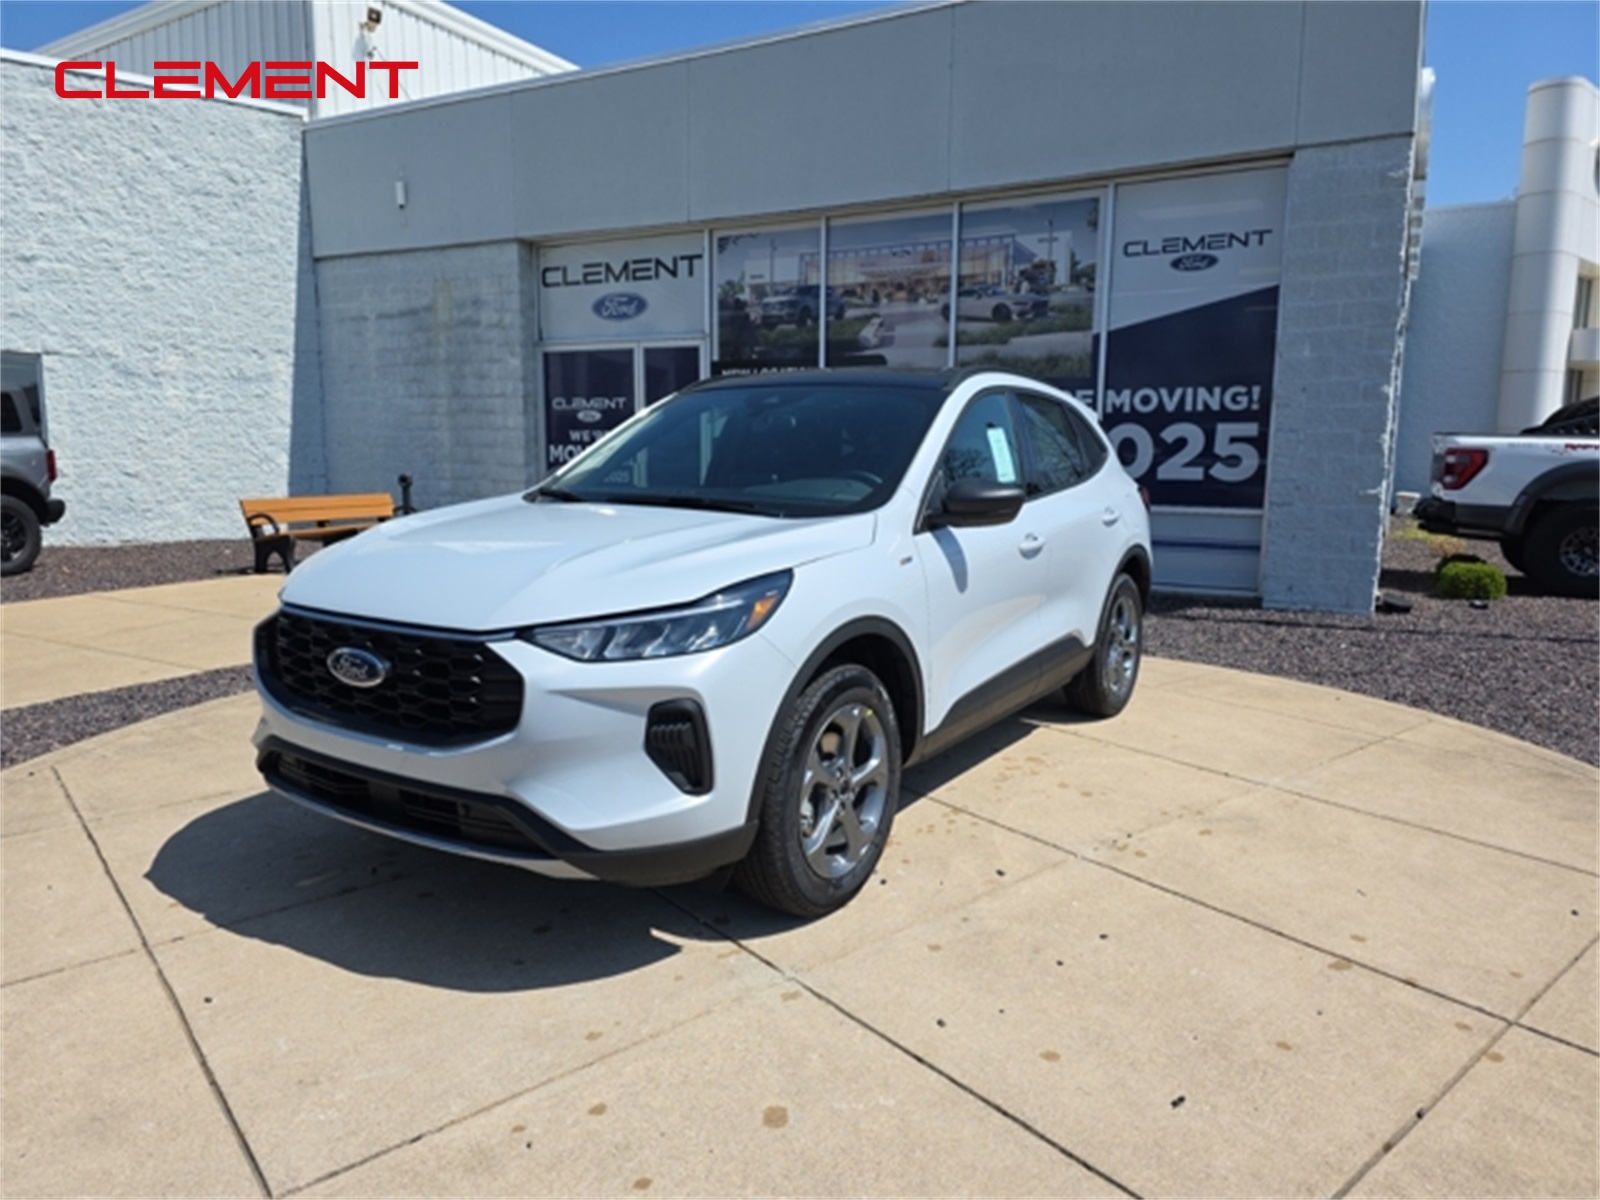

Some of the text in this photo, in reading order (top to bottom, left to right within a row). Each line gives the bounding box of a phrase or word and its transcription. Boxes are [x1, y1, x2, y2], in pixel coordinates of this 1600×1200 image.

[1123, 229, 1273, 258] CLEMENT
[541, 254, 703, 288] CLEMENT
[599, 295, 640, 318] Ford
[552, 397, 626, 410] CLEMENT
[1105, 385, 1261, 413] MOVING!
[1107, 421, 1260, 482] 025
[334, 653, 370, 681] Ford
